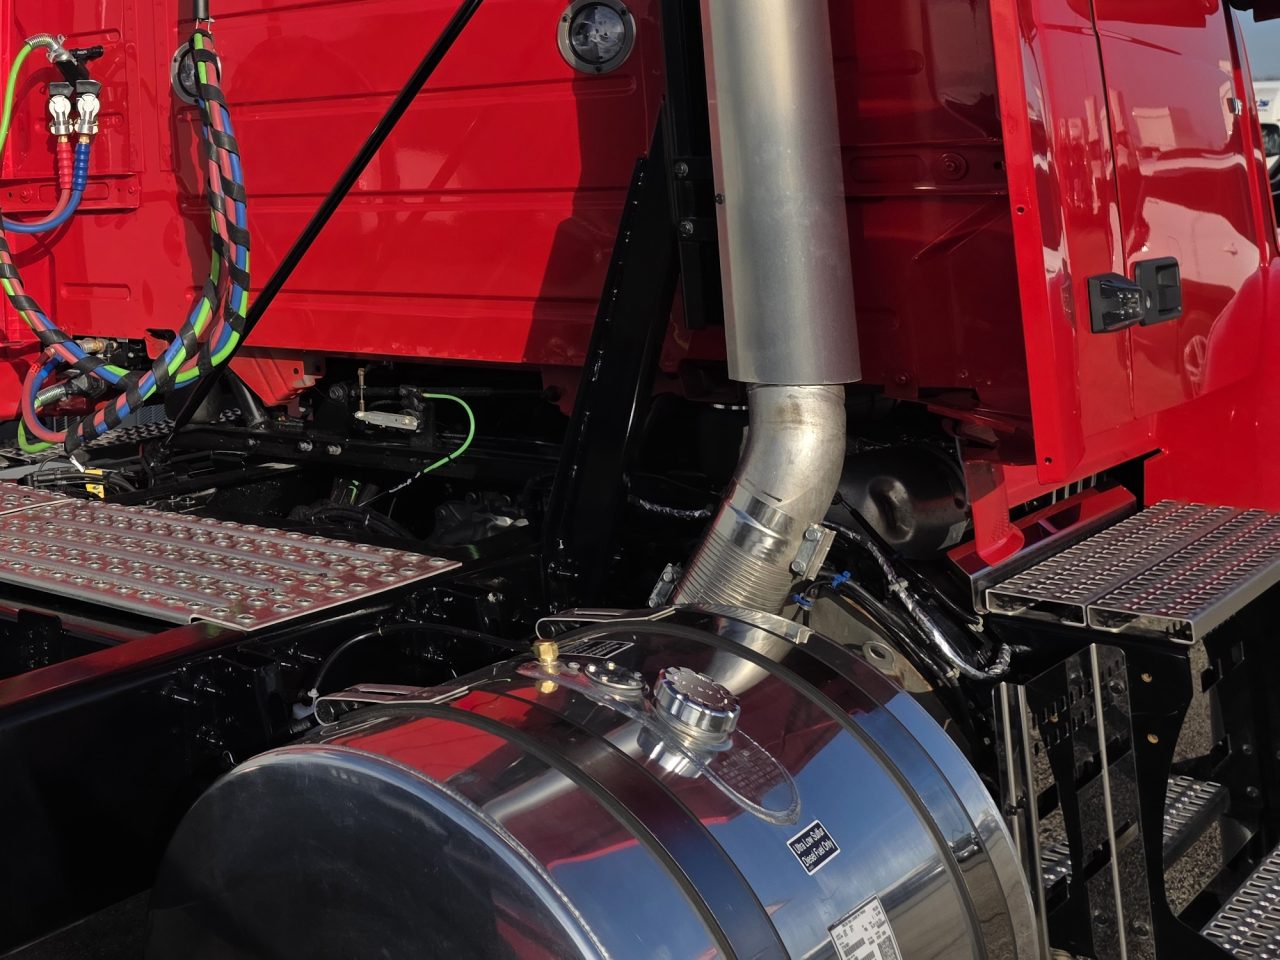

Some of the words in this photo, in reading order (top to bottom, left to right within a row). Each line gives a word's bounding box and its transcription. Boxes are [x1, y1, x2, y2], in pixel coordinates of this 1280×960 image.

[792, 843, 807, 854] Ultra
[802, 836, 814, 847] Low
[810, 828, 824, 840] Sulfur
[802, 850, 817, 866] Diesel
[813, 844, 825, 857] Fuel
[821, 839, 834, 850] Only
